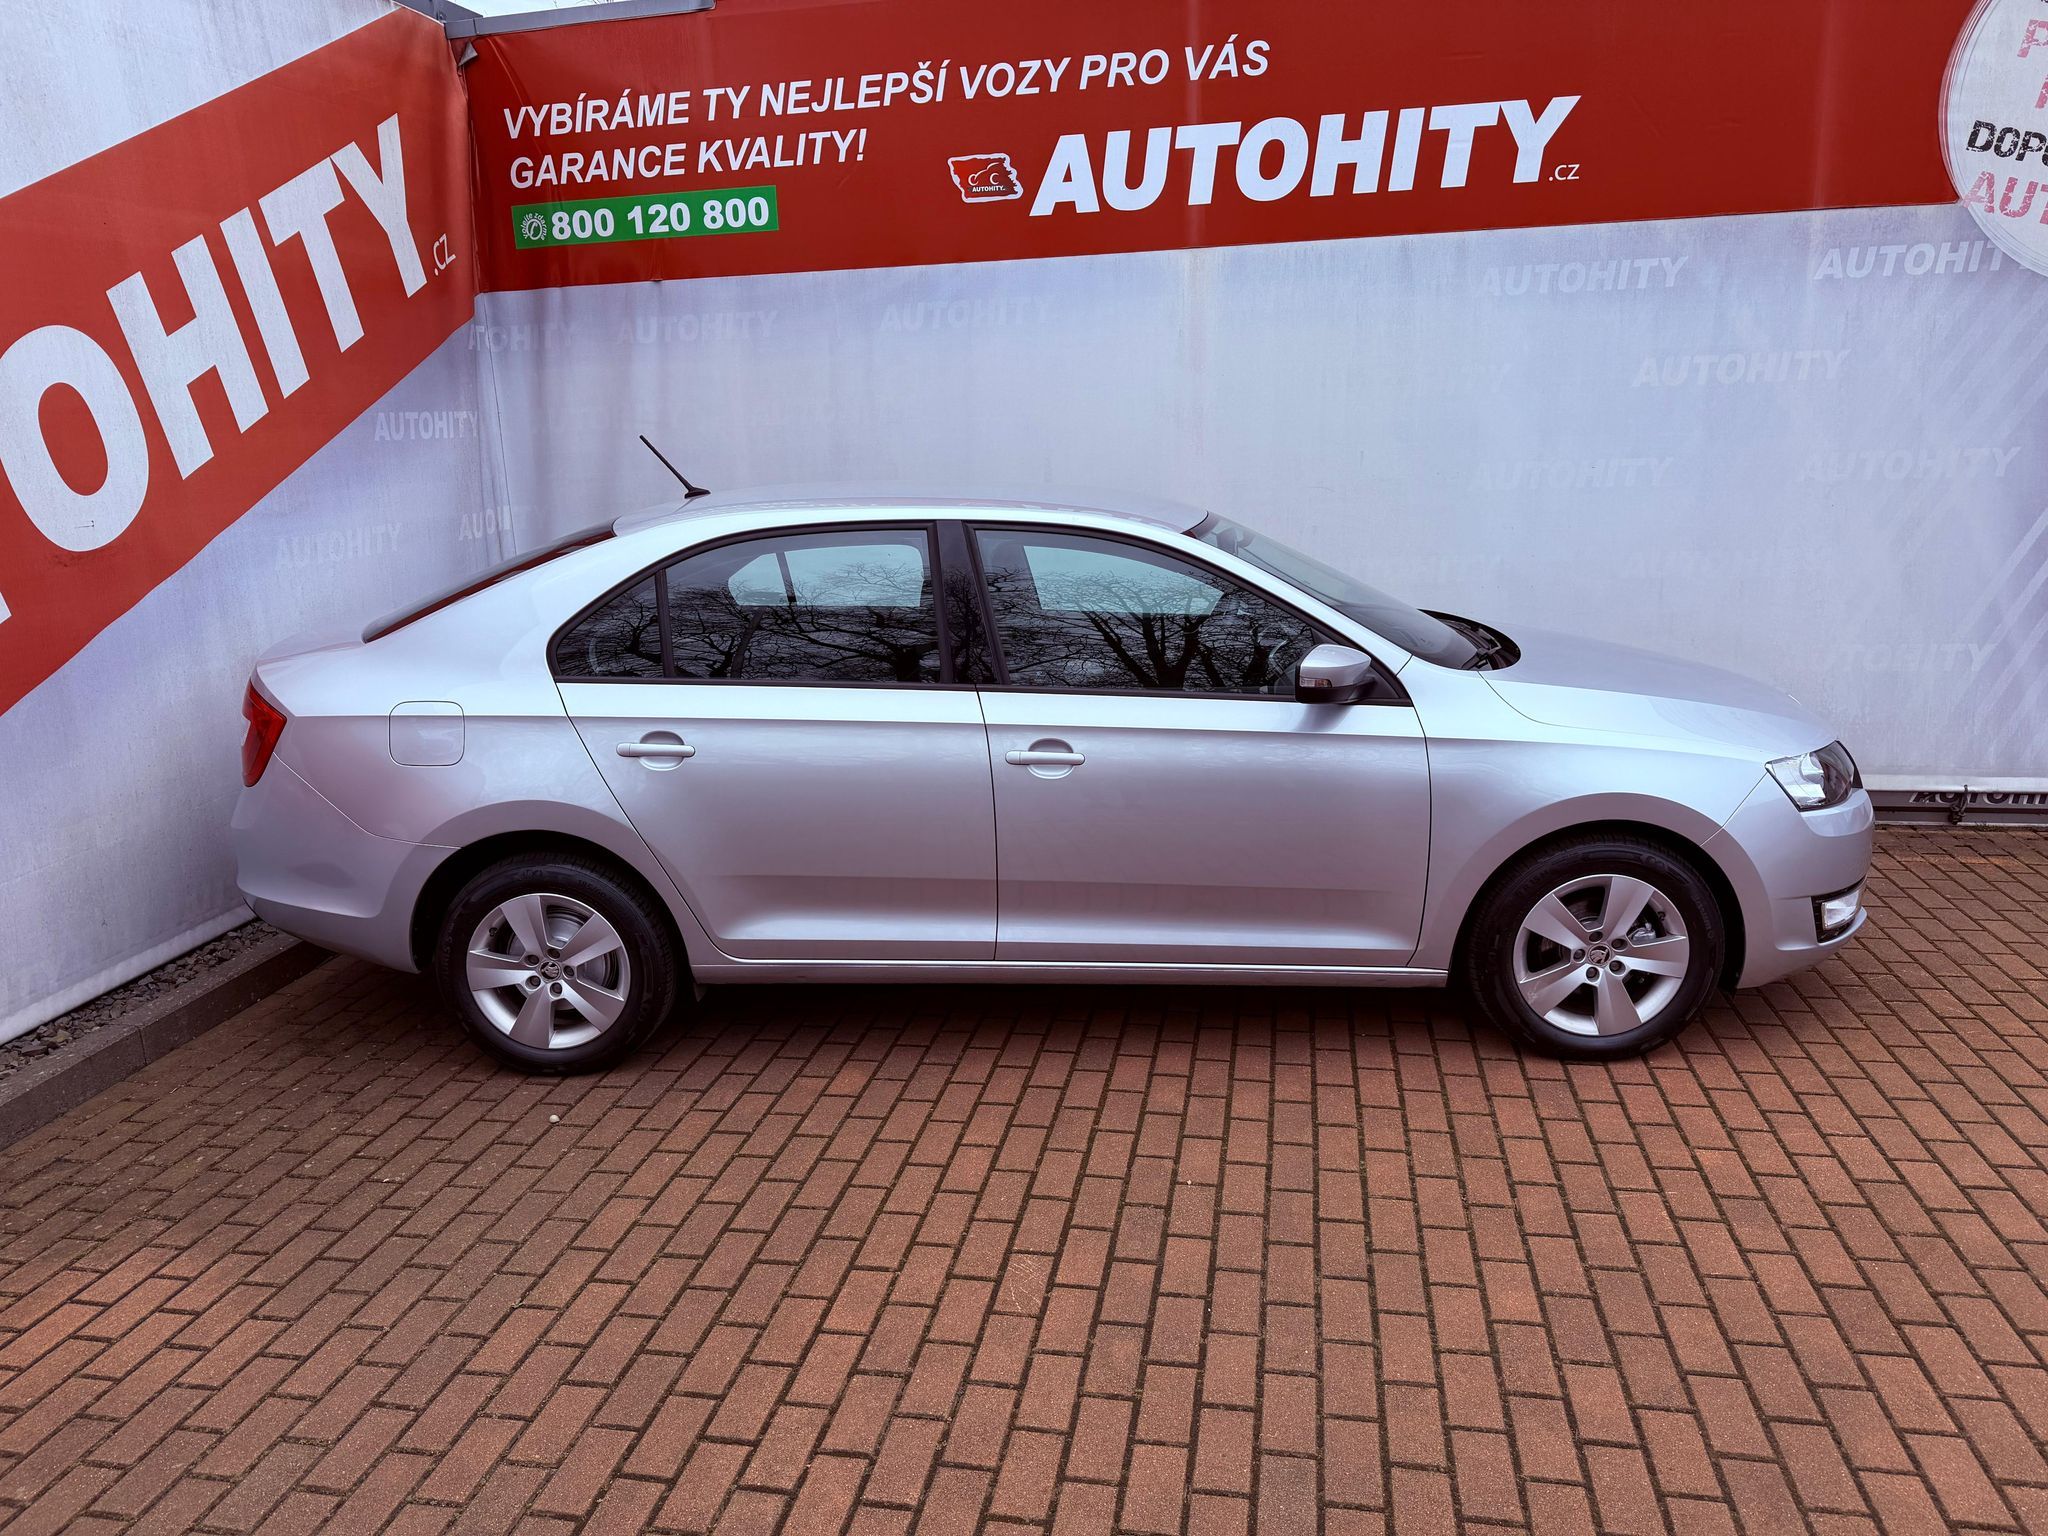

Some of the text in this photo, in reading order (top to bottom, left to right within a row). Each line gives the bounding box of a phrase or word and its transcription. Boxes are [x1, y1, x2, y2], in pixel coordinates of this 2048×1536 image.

[503, 33, 1271, 140] VYBÍRÁME TY NEJLEPŠÍ VOZY PRO VÁS
[510, 127, 868, 189] GARANCE KVALITY!
[1965, 119, 2048, 167] DOP
[551, 195, 770, 241] 800 120 800
[1813, 240, 2031, 281] AUTOHIT
